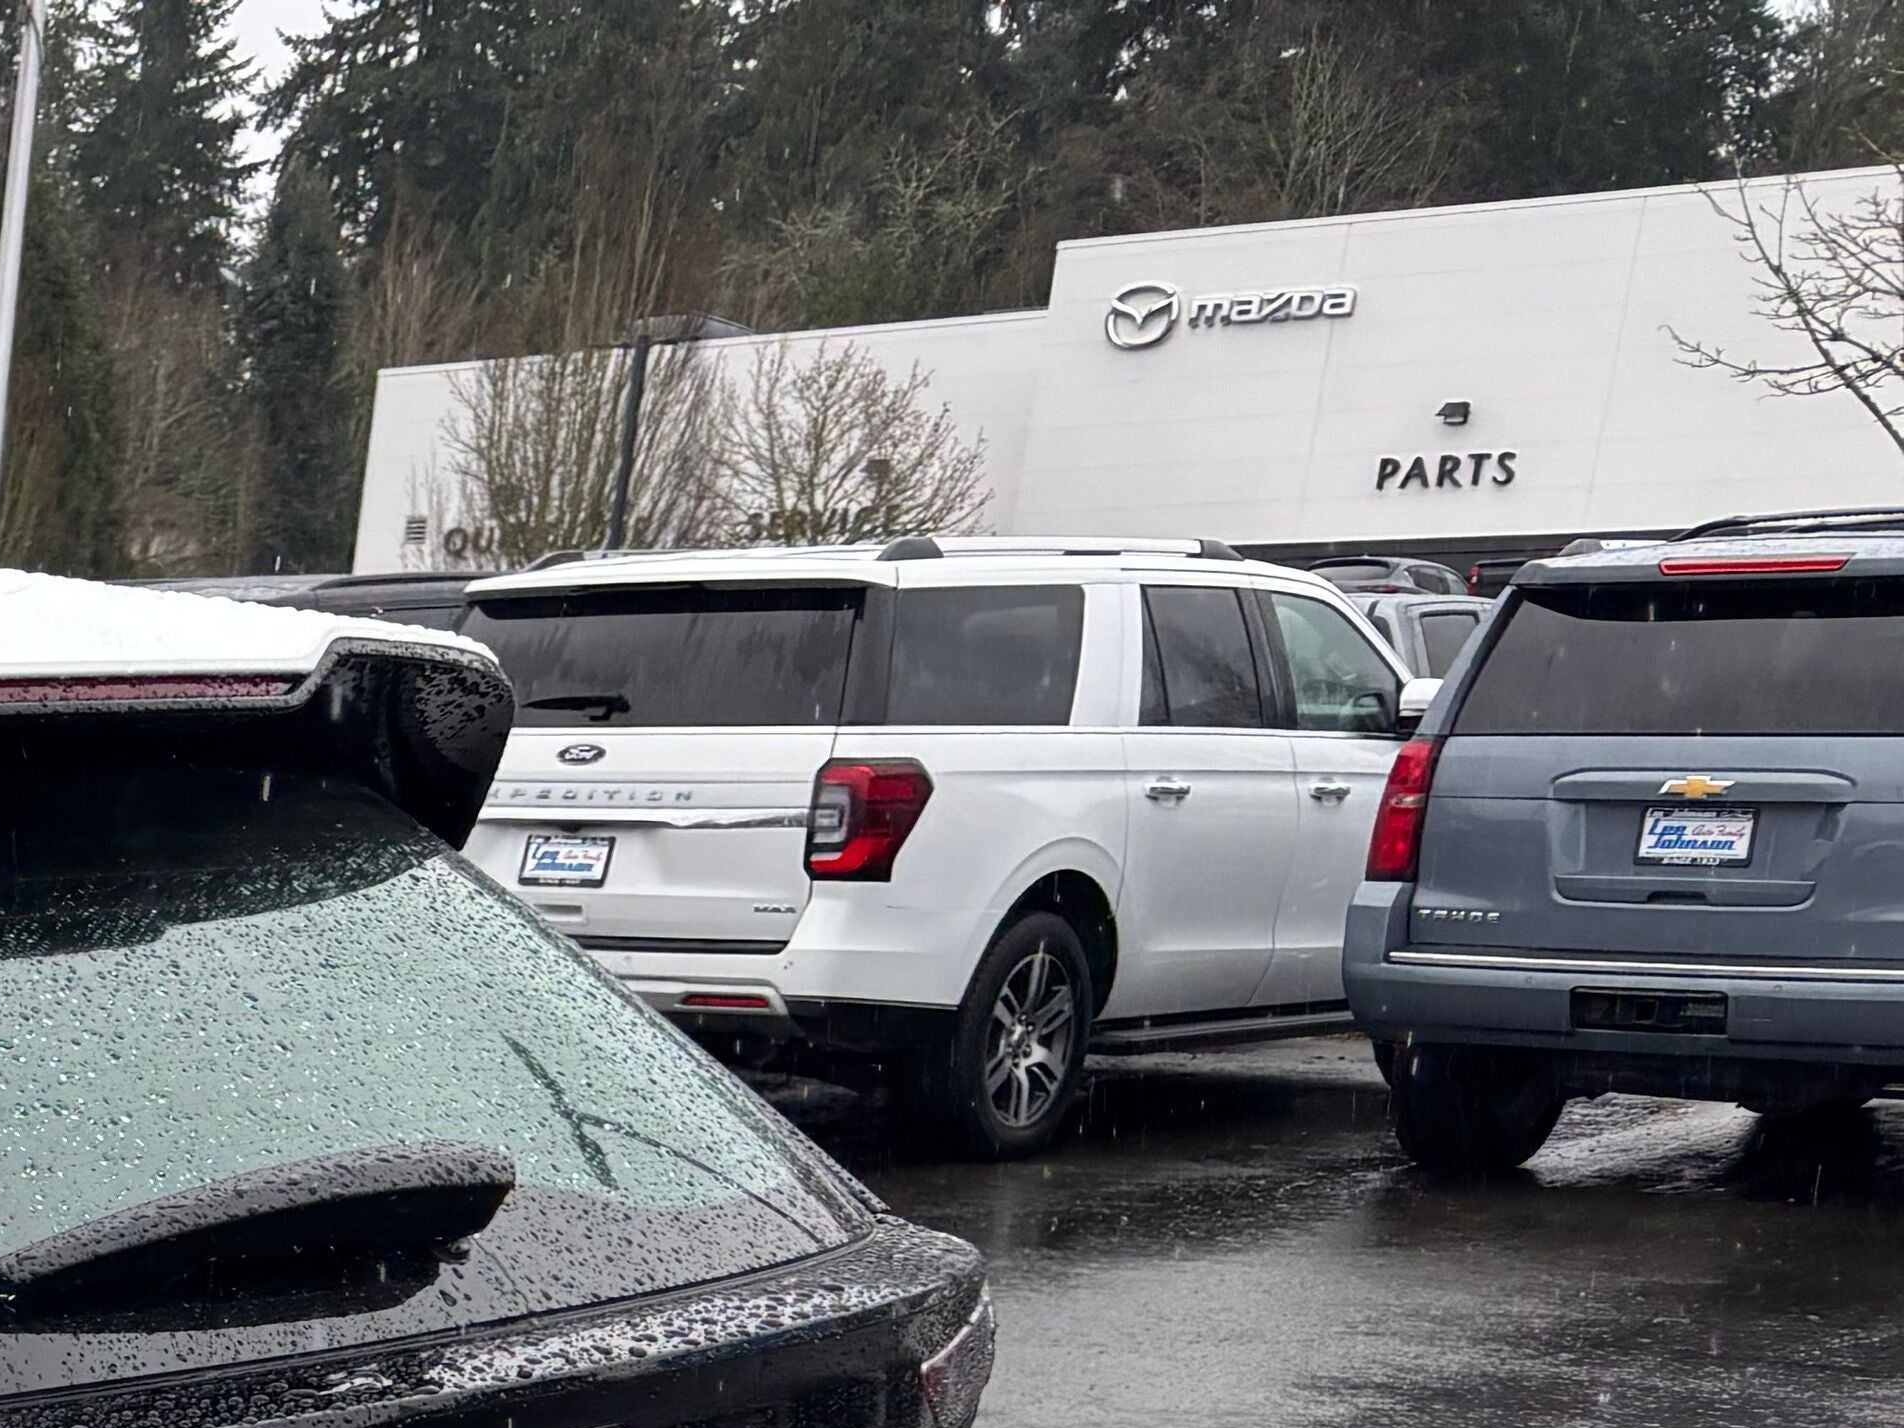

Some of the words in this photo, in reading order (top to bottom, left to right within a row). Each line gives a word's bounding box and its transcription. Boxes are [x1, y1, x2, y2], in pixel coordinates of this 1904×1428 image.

[1376, 452, 1518, 490] PARTS
[488, 787, 693, 802] XPEDITION
[1418, 909, 1500, 924] TAHOE
